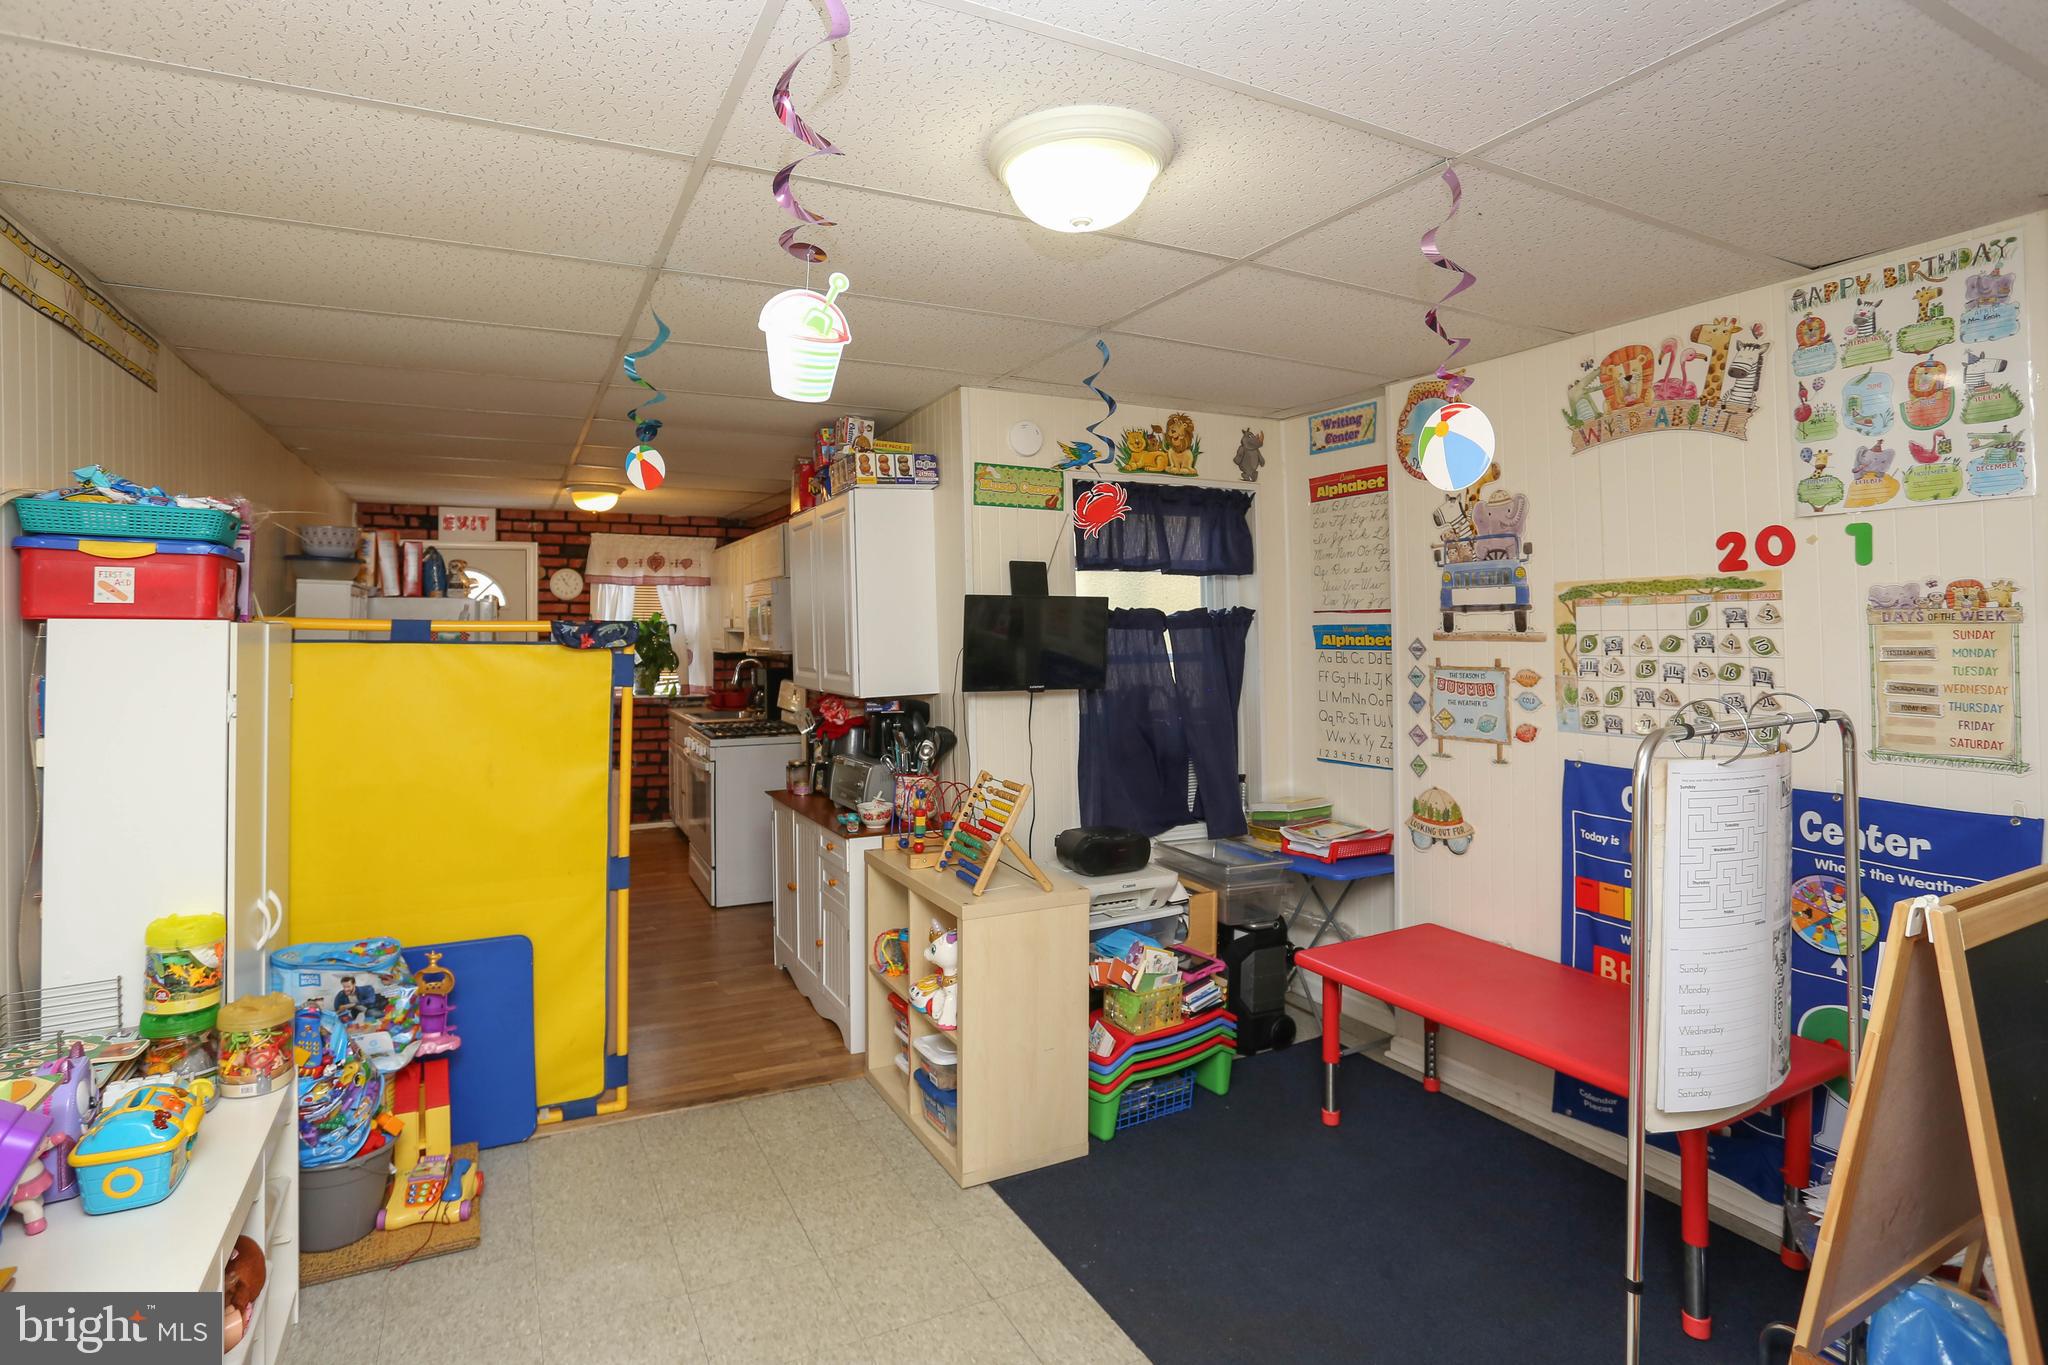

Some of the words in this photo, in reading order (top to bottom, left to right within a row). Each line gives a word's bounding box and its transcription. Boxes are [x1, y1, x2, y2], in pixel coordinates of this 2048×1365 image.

[1791, 273, 1871, 312] HAPPY
[1883, 237, 2017, 289] BIRTHDAY
[1321, 414, 1363, 431] Writing
[1325, 429, 1360, 445] Center
[1913, 468, 1948, 477] NOVEMBER
[1976, 462, 2018, 472] DECEMBER
[1317, 477, 1385, 498] Alphabet
[442, 514, 489, 533] EXIT
[1845, 522, 1873, 566] 1
[98, 570, 123, 578] FIRST
[1732, 610, 1738, 621] 2
[1765, 609, 1773, 621] 3
[1882, 611, 1924, 623] DAYS
[1927, 613, 1938, 621] OF
[1940, 612, 1956, 621] THE
[1960, 610, 2005, 622] WEEK
[1322, 634, 1392, 647] Alphabet
[1952, 630, 1996, 640] SUNDAY
[1585, 639, 1592, 648] 4
[1611, 640, 1617, 649] 5
[1640, 641, 1646, 650] 6
[1668, 639, 1675, 648] 7
[1701, 636, 1707, 646] 8
[1728, 640, 1734, 650] 9
[1756, 640, 1770, 651] 10
[1318, 651, 1332, 663] Aa
[1335, 651, 1348, 664] Bb
[1351, 651, 1364, 664] Cc
[1369, 651, 1382, 665] Dd
[1385, 652, 1392, 665] E
[1952, 648, 1998, 658] MONDAY
[1585, 662, 1593, 670] 11
[1609, 663, 1618, 673] 12
[1640, 664, 1650, 674] 13
[1669, 666, 1679, 676] 14
[1697, 668, 1709, 678] 15
[1724, 667, 1734, 678] 16
[1757, 671, 1767, 681] 17
[1951, 666, 1999, 676] TUESDAY
[1318, 671, 1329, 683] Ff
[1331, 671, 1345, 688] Gg
[1348, 672, 1361, 684] Hh
[1365, 672, 1371, 685] Ii
[1373, 673, 1383, 690] Jj
[1385, 673, 1393, 686] K
[1437, 677, 1496, 697] SUMMER
[1943, 684, 2008, 695] WEDNESDAY
[1318, 690, 1329, 702] Ll
[1331, 691, 1350, 703] Mm
[1352, 692, 1366, 705] Nn
[1368, 693, 1384, 706] Oo
[1585, 693, 1594, 702] 18
[1610, 691, 1619, 700] 19
[1640, 691, 1650, 701] 20
[1761, 697, 1776, 708] 24
[1948, 702, 2004, 713] THURSDAY
[1318, 709, 1335, 726] Qq
[1336, 711, 1346, 724] Rr
[1349, 712, 1358, 725] Ss
[1360, 713, 1370, 726] Tt
[1374, 714, 1386, 727] Uu
[1585, 715, 1596, 724] 25
[1608, 719, 1618, 728] 26
[1640, 719, 1651, 729] 27
[1958, 720, 1995, 732] FRIDAY
[1760, 728, 1772, 738] 31
[1326, 729, 1346, 743] Ww
[1349, 732, 1360, 744] Xx
[1363, 735, 1374, 751] Yy
[1380, 736, 1393, 749] Zz
[1949, 738, 2005, 750] SATURDAY
[1410, 820, 1437, 836] LOOKING
[1438, 828, 1450, 836] OUT
[1580, 829, 1608, 846] Today
[1610, 835, 1620, 846] is
[1800, 810, 1932, 860] Ceter
[1870, 868, 1895, 884] the
[1679, 963, 1708, 974] Sunday
[1678, 985, 1711, 995] Monday
[1678, 1005, 1710, 1016] Tuesday
[1679, 1025, 1724, 1036] Wednesday
[1678, 1046, 1714, 1057] Thursday
[1677, 1068, 1701, 1078] Friday
[1678, 1088, 1712, 1098] Saturday
